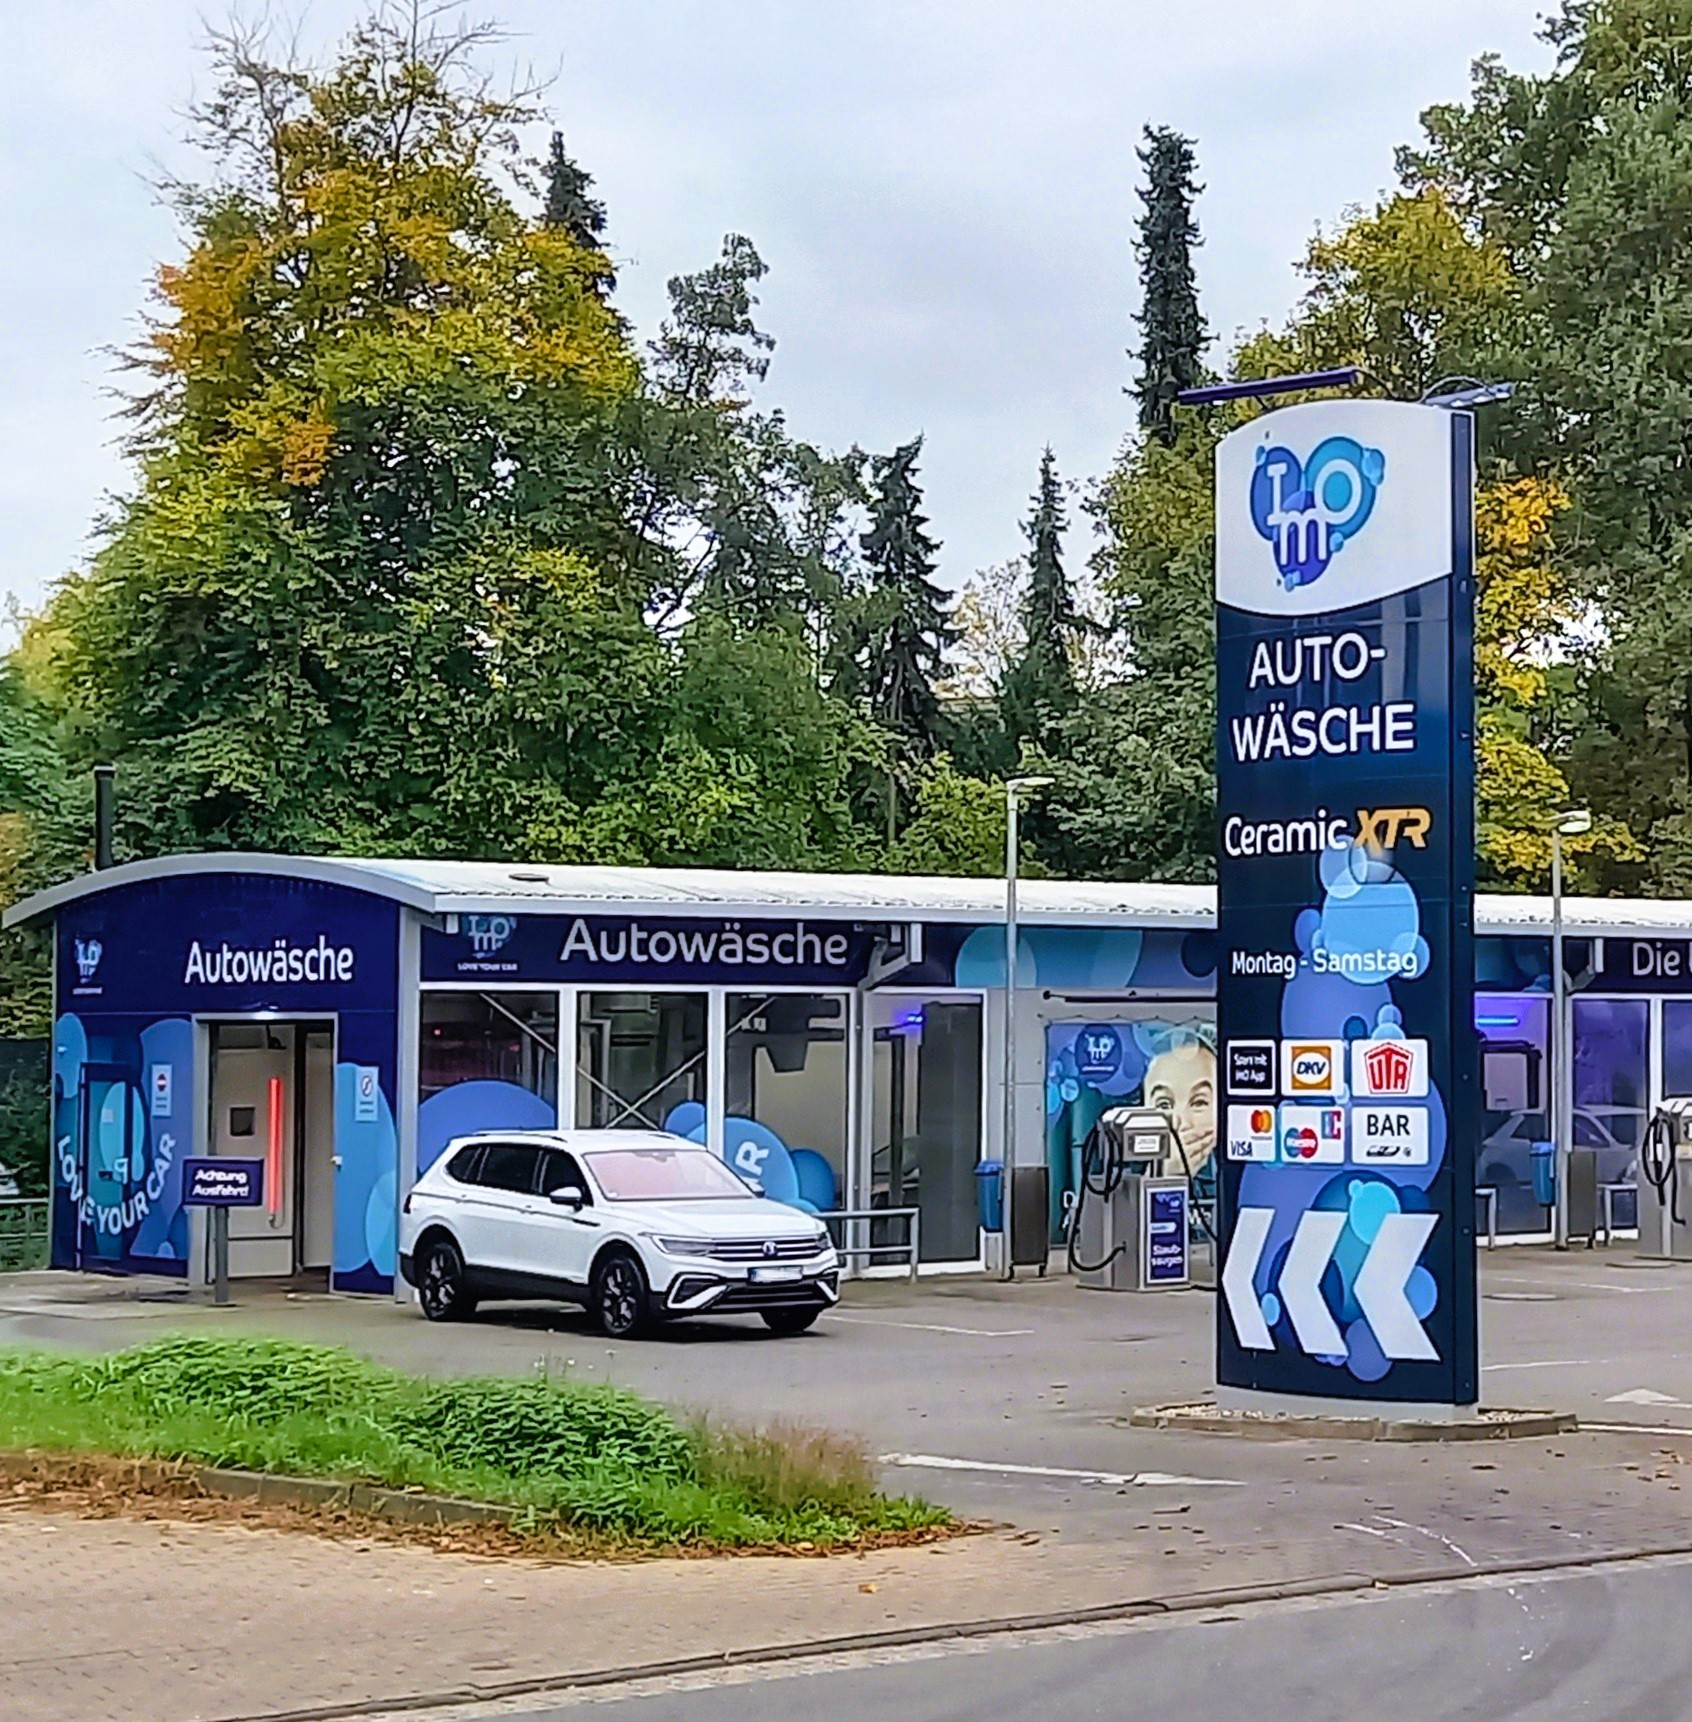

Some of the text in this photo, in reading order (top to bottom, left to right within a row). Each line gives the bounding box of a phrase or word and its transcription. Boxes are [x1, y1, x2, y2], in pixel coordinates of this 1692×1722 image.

[1249, 632, 1387, 689] AUTO-
[1232, 702, 1416, 762] WÄSCHE
[1225, 808, 1432, 857] Ceramic XTR
[184, 935, 354, 983] Autowäsche
[559, 917, 848, 966] Autowäsche
[1231, 950, 1297, 980] Montag
[1312, 947, 1418, 976] Samstag
[1632, 941, 1681, 977] Die
[1296, 1061, 1327, 1076] DKV
[1367, 1046, 1409, 1090] UTA
[1367, 1113, 1411, 1136] BAR
[1230, 1140, 1254, 1157] VISA
[96, 1190, 150, 1235] YOUR
[147, 1133, 176, 1201] CAR
